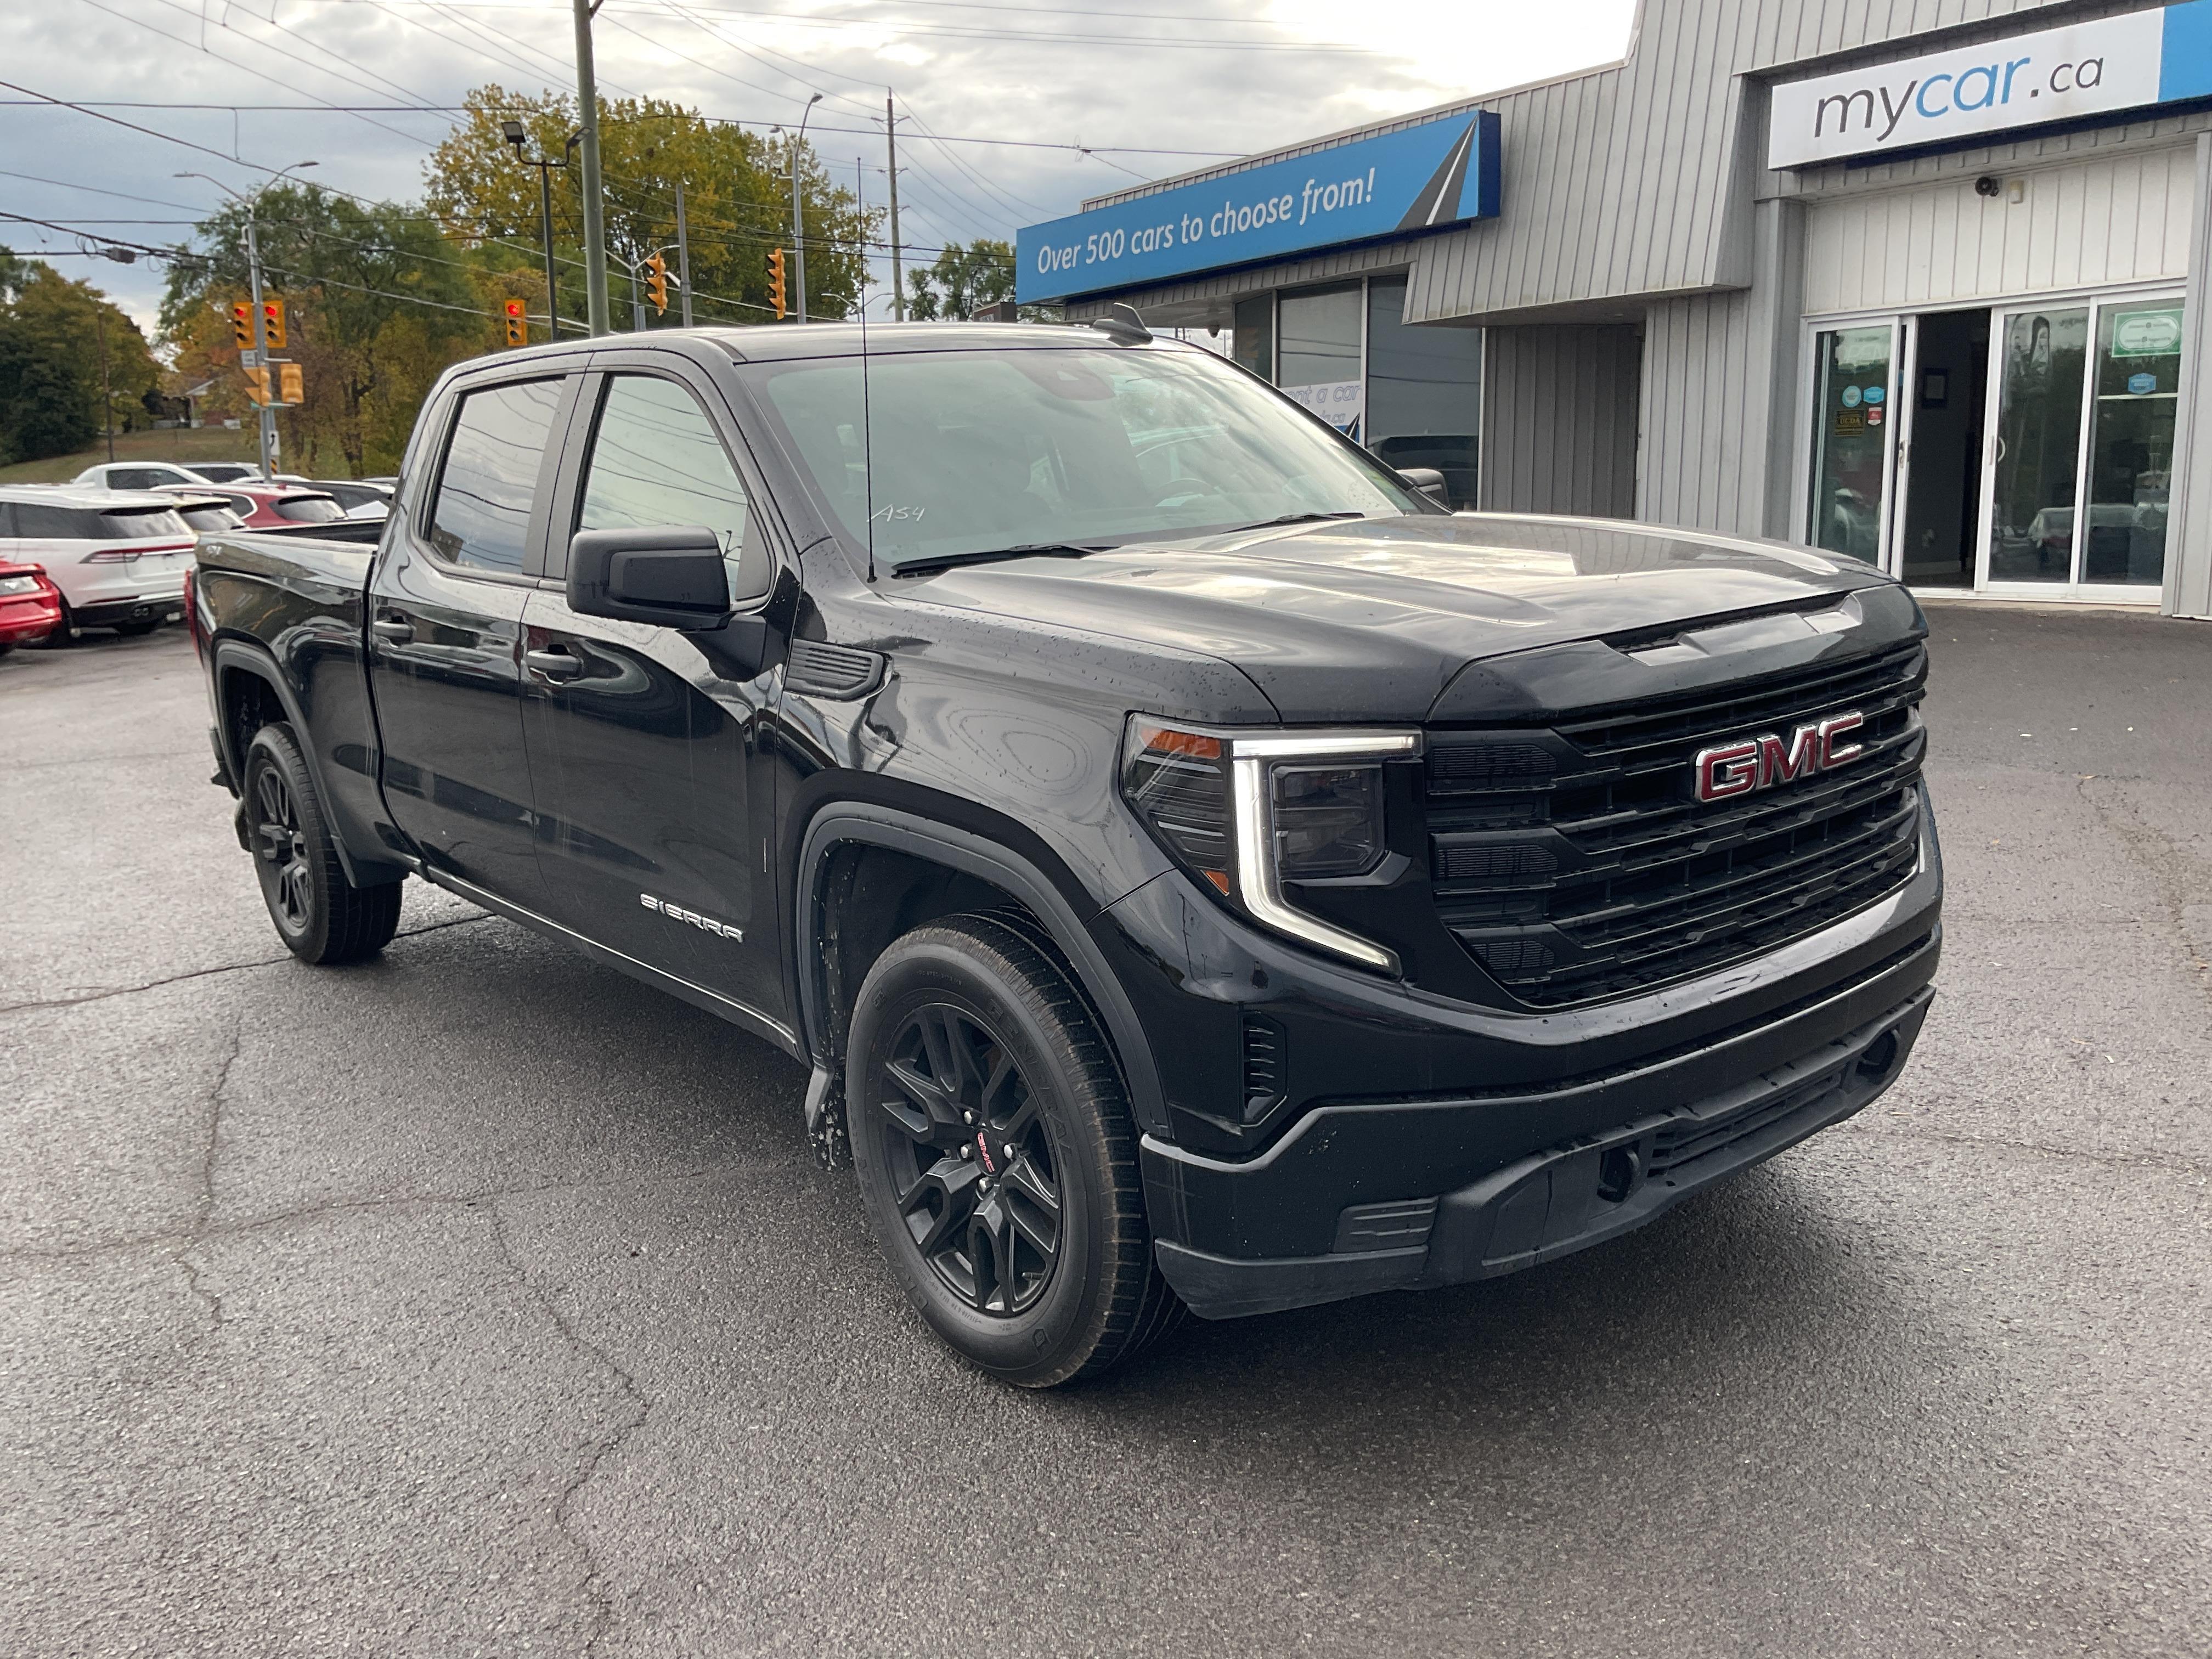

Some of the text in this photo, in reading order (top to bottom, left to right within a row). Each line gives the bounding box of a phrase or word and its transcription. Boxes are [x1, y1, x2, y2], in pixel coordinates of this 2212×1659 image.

[1813, 57, 2104, 143] mycar.ca
[1037, 167, 1376, 274] Over 500 cars to choose from!
[1317, 388, 1328, 404] a
[1333, 385, 1361, 402] car
[1694, 711, 1864, 803] GMC
[640, 894, 743, 943] SIERRA
[977, 1132, 996, 1173] GMC
